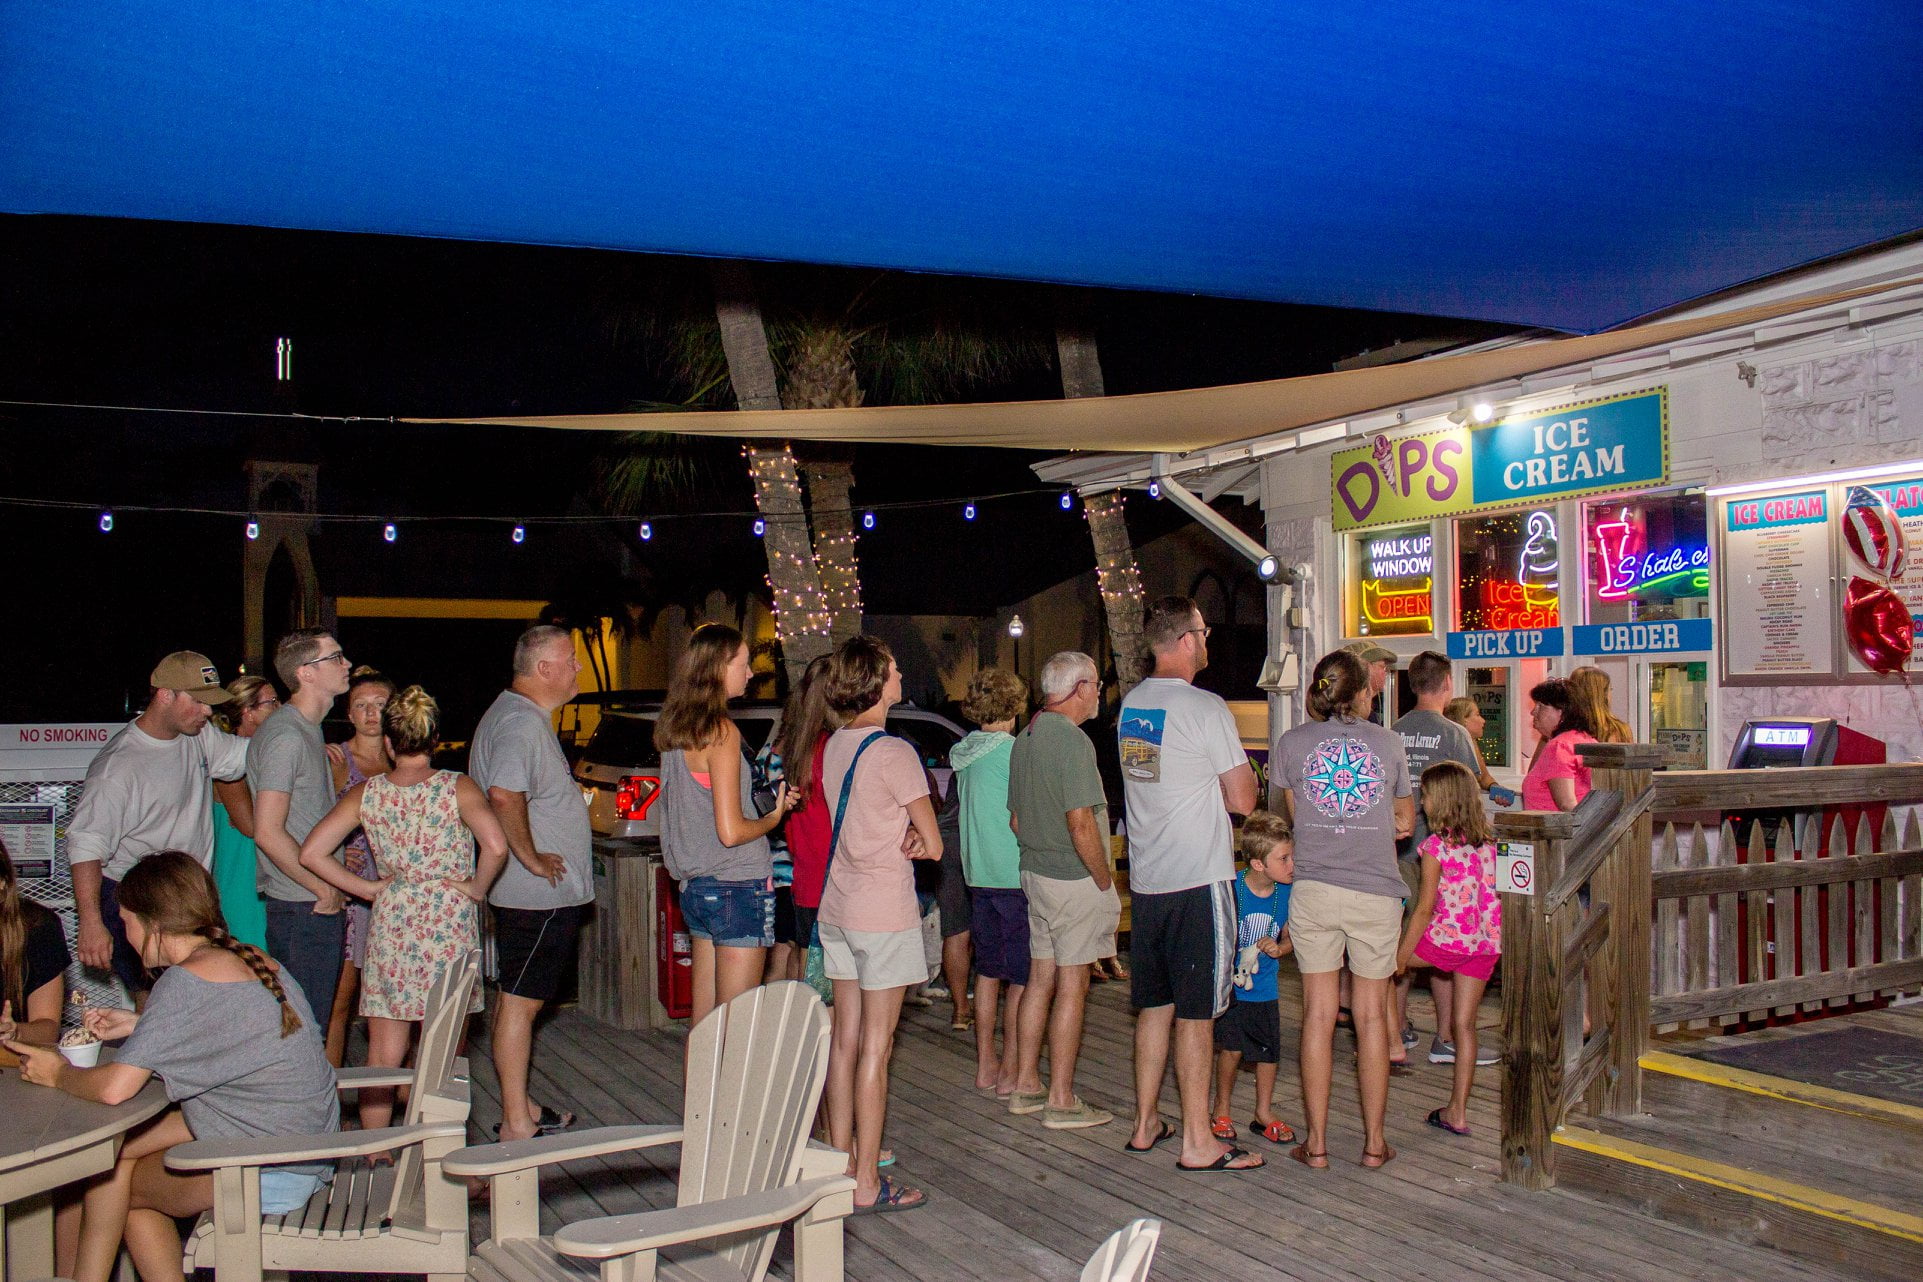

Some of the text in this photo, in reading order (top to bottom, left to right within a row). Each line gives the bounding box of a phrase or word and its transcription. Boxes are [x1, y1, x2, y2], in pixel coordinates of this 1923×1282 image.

[1533, 417, 1590, 454] ICE
[1503, 444, 1626, 490] CREAM
[1734, 495, 1823, 526] ICE CREAM
[1371, 536, 1432, 558] WALK UP
[1372, 556, 1432, 577] WINDOW
[1489, 579, 1525, 604] Ice
[1378, 594, 1430, 617] OPEN
[1464, 630, 1543, 656] PICK UP
[1600, 623, 1680, 651] ORDER
[20, 728, 108, 742] NO SMOKING
[1765, 731, 1798, 743] ATM
